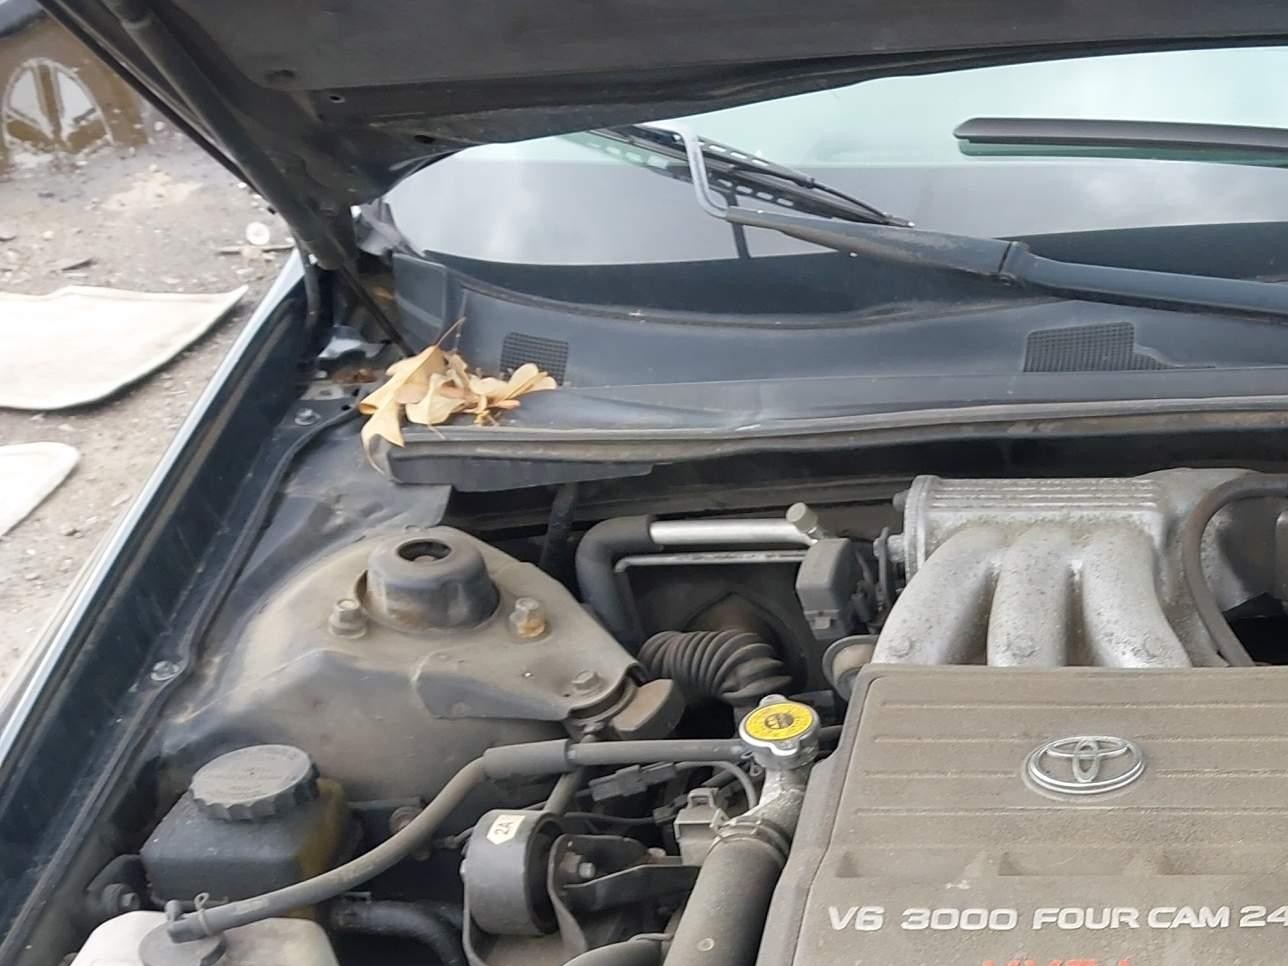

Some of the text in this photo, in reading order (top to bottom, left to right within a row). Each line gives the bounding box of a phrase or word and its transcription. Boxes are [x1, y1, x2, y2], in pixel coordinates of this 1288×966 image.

[827, 905, 884, 930] V6
[900, 907, 1017, 930] 3000
[1031, 906, 1140, 930] FOUR
[1147, 906, 1229, 929] CAM
